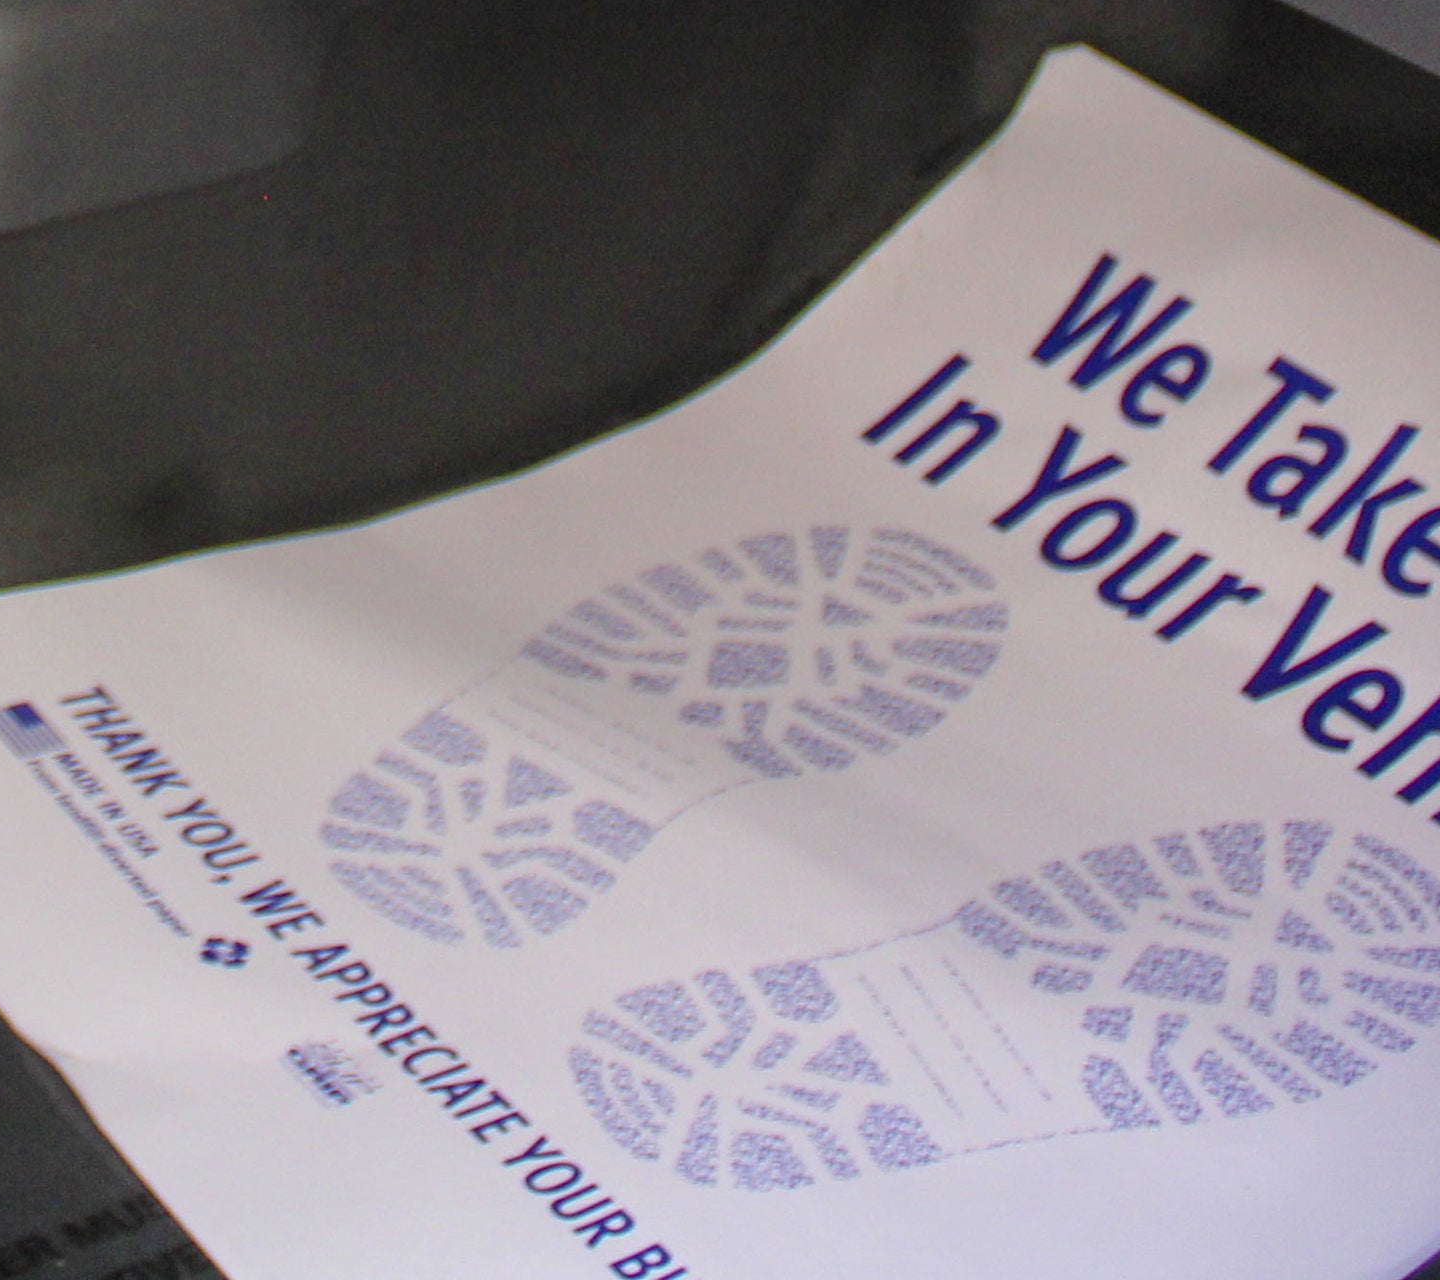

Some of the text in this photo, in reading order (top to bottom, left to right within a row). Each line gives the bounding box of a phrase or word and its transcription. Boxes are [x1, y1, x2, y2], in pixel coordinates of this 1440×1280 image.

[1030, 251, 1213, 429] We
[859, 351, 1003, 488] In
[988, 422, 1266, 644] Your
[59, 684, 192, 799] THANK
[163, 796, 262, 885] YOU,
[239, 878, 325, 941] WE
[289, 943, 532, 1146] APPRECIATE
[501, 1134, 637, 1250] YOUR
